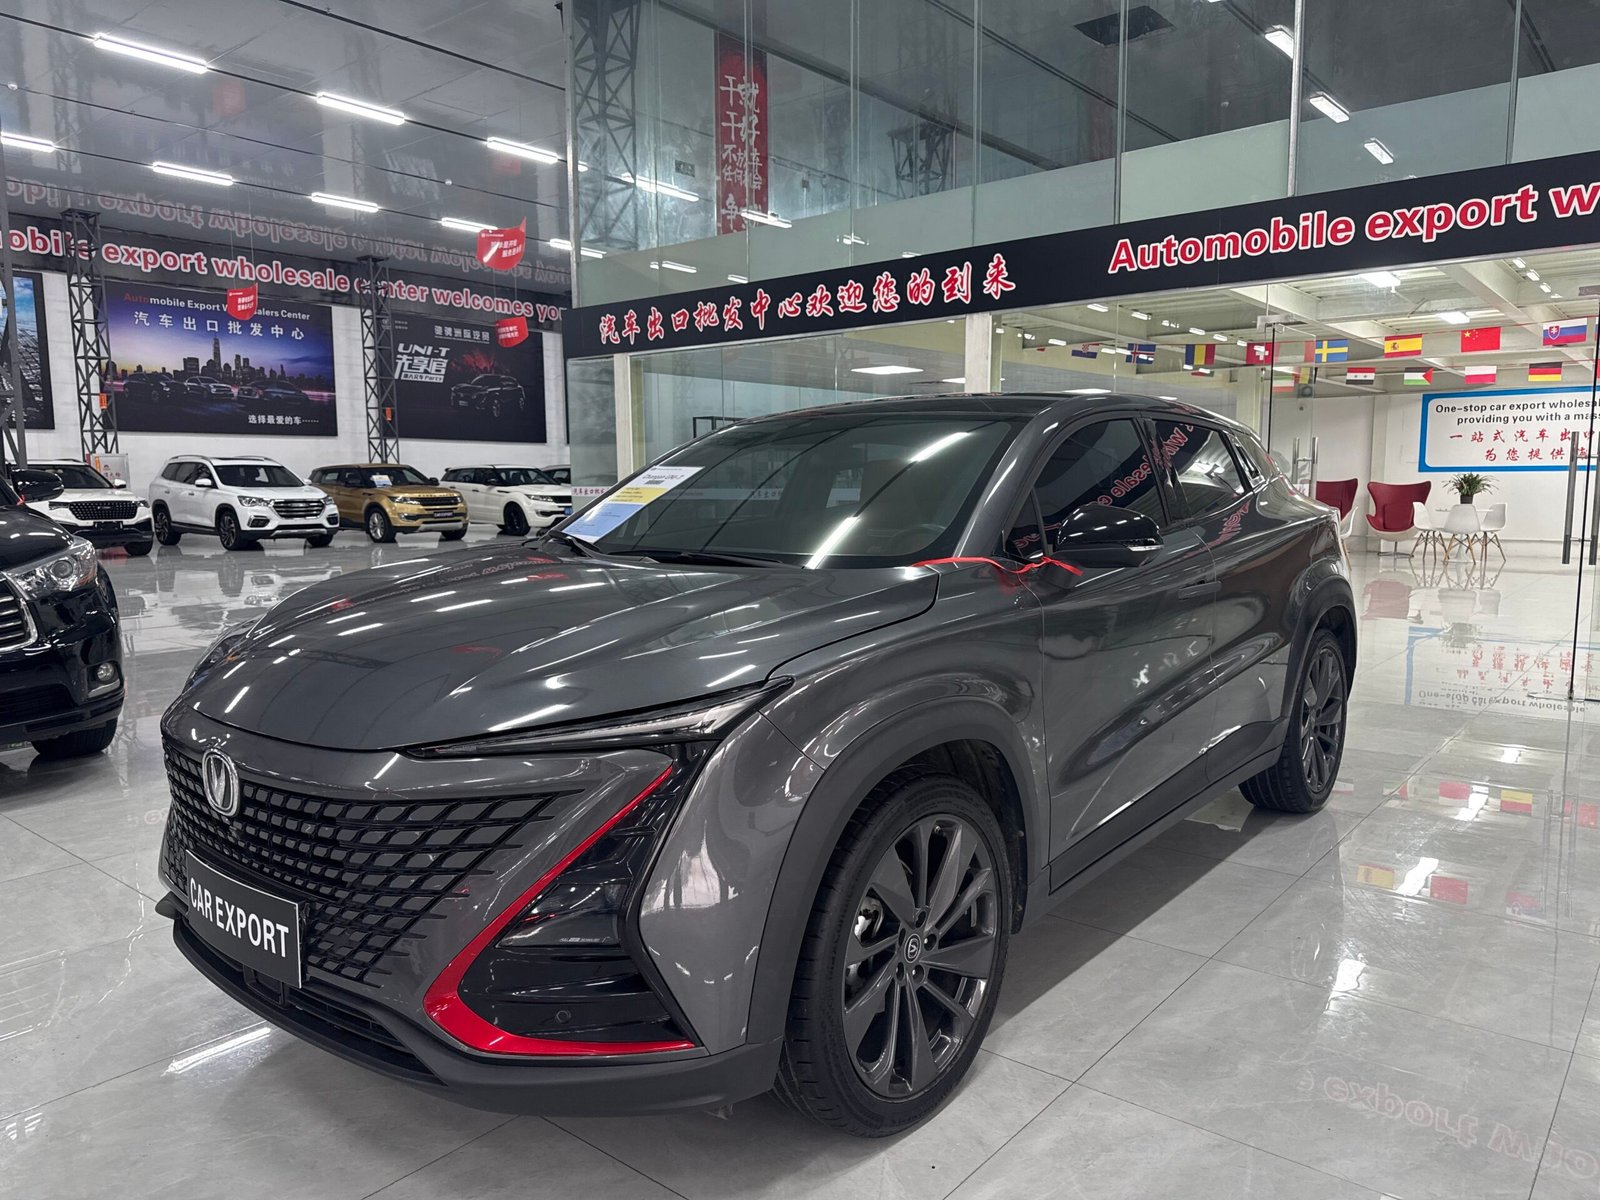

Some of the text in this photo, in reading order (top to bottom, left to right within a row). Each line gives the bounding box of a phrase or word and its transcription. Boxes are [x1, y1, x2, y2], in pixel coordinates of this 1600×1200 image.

[1108, 211, 1354, 274] Automobile
[1365, 184, 1538, 245] export
[102, 242, 207, 275] export
[211, 255, 350, 293] wholesale
[432, 287, 534, 317] welcomes
[124, 293, 186, 308] Automobile
[187, 300, 220, 312] Export
[281, 309, 311, 321] Center
[599, 253, 1016, 345] 汽车出口批发中心欢迎您的到来
[134, 311, 304, 341] 汽车出口批发中心
[397, 343, 450, 357] UNI-T
[1435, 402, 1487, 414] One-stop
[1489, 404, 1506, 412] car
[1509, 401, 1547, 412] export
[1457, 414, 1509, 426] providing
[1512, 414, 1533, 425] you
[1535, 411, 1561, 421] with
[190, 877, 289, 957] CAR EXPORT
